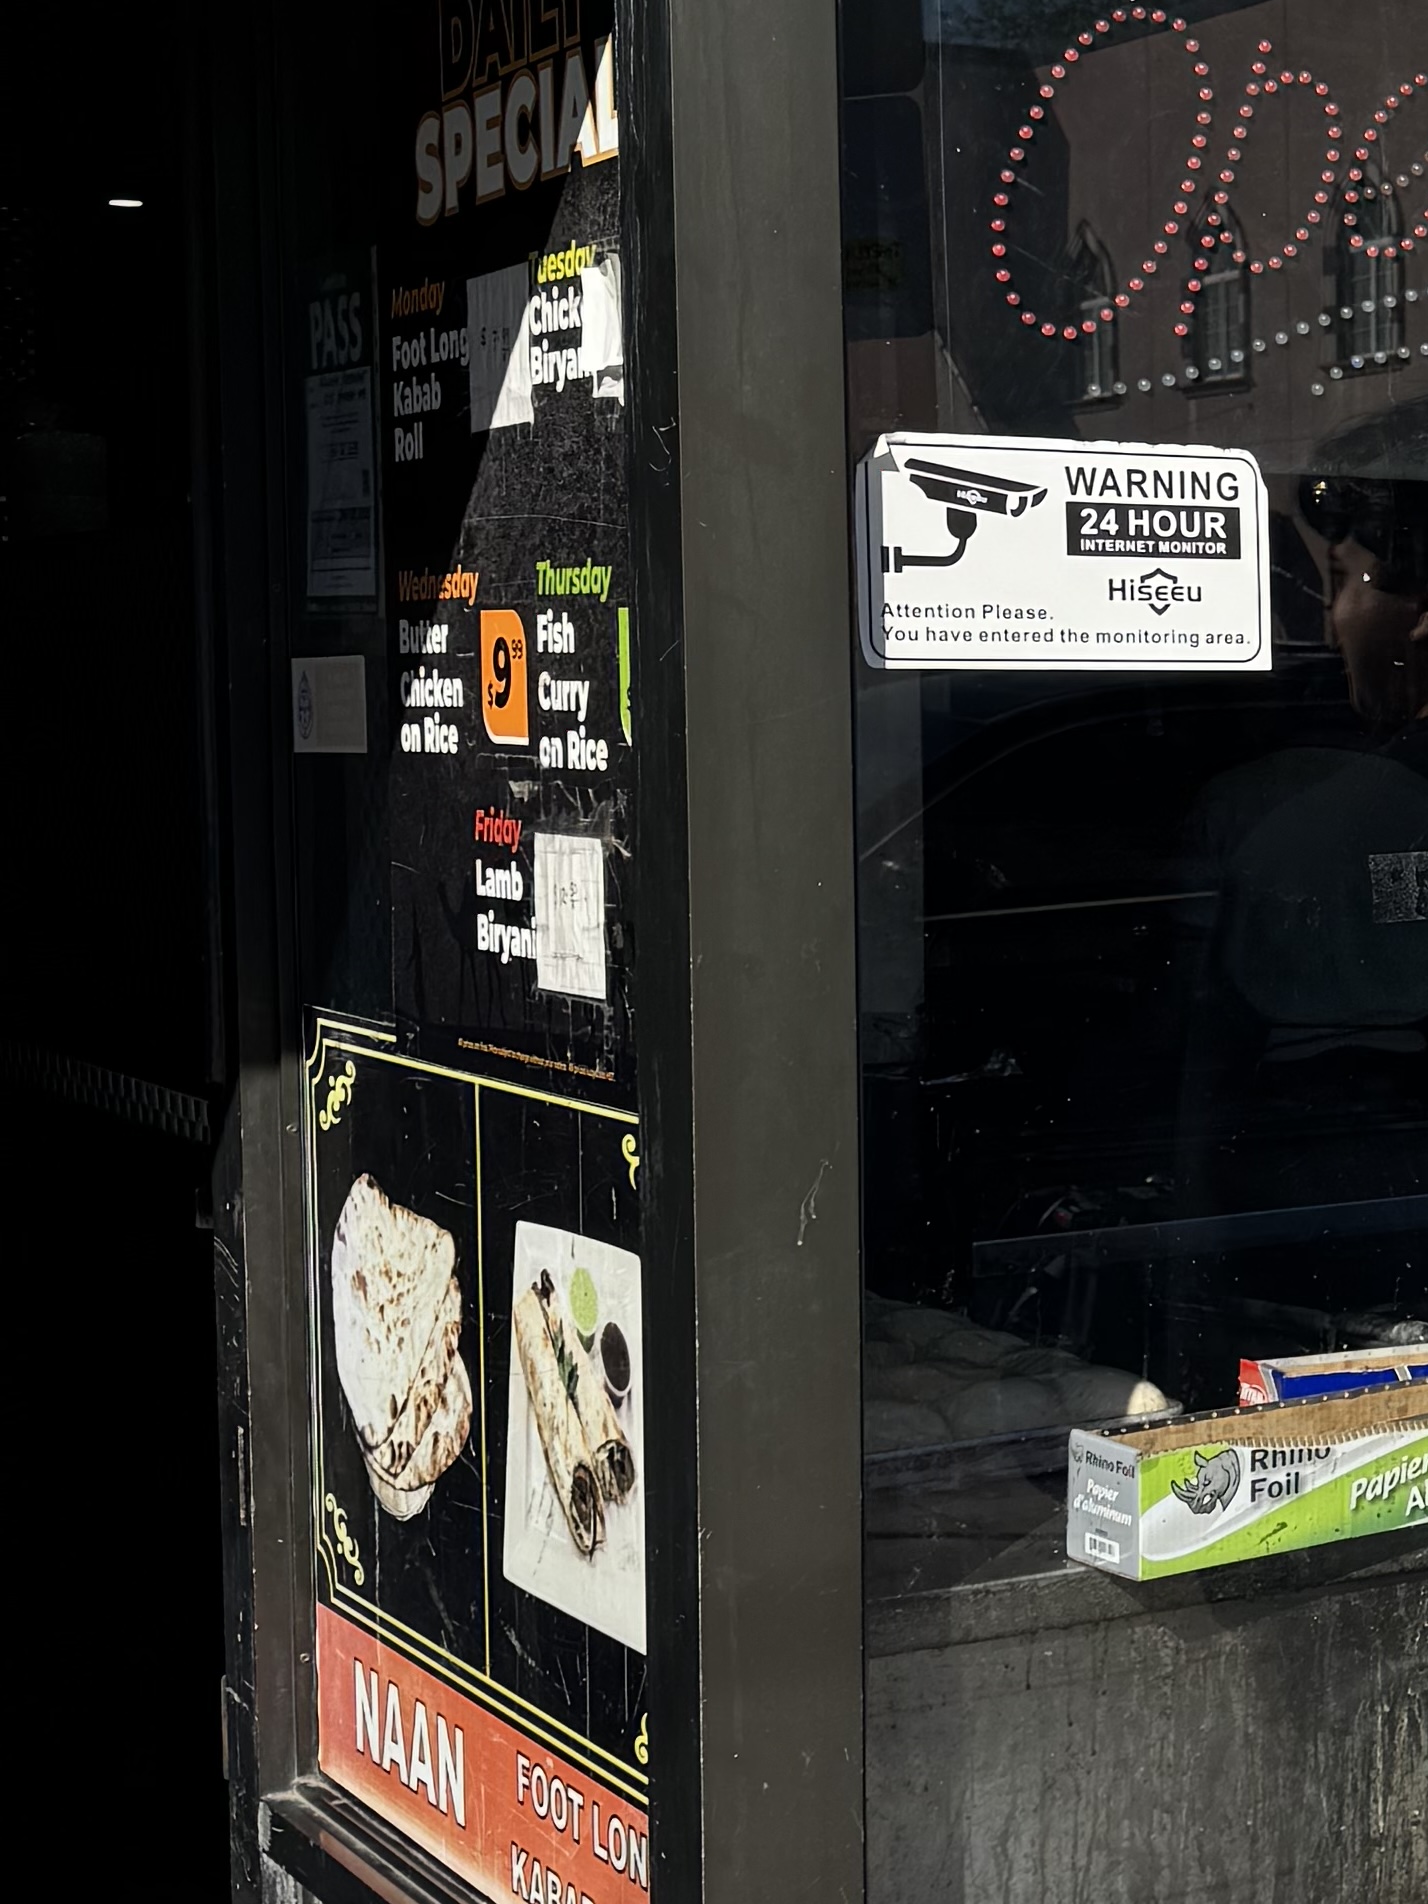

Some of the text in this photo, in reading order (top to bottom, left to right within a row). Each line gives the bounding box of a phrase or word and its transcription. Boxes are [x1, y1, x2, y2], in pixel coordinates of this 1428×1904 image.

[414, 33, 618, 227] SPECIAL
[391, 277, 445, 320] Monday
[528, 286, 582, 336] Chick
[308, 291, 362, 370] PASS
[391, 332, 426, 371] Foot
[429, 326, 469, 367] Long
[528, 337, 594, 393] Birya
[393, 374, 441, 417] Kabab
[394, 427, 424, 462] Roll
[1065, 466, 1240, 501] WARNING
[1079, 508, 1227, 539] 24 HOUR
[1079, 538, 1227, 555] INTERNET MONITOR
[397, 564, 479, 606] Wednesday
[536, 558, 612, 603] Thursday
[536, 608, 575, 654] Fish
[880, 603, 1054, 621] Attention Please.
[399, 617, 449, 655] Butter
[881, 626, 1251, 648] You have entered the monitoring area.
[400, 665, 464, 709] Chicken
[538, 670, 590, 723] Curry
[400, 713, 459, 755] on Rice
[539, 724, 609, 772] on Rice
[474, 806, 522, 854] Friday
[475, 858, 524, 901] Lamb
[476, 909, 537, 965] Biryani
[1085, 1451, 1136, 1479] Rhino Foil
[1086, 1478, 1120, 1502] Papier
[1250, 1471, 1300, 1503] Foil
[1073, 1493, 1132, 1527] d'aluminum
[353, 1656, 466, 1828] NAAN
[516, 1749, 649, 1892] FOOT LON
